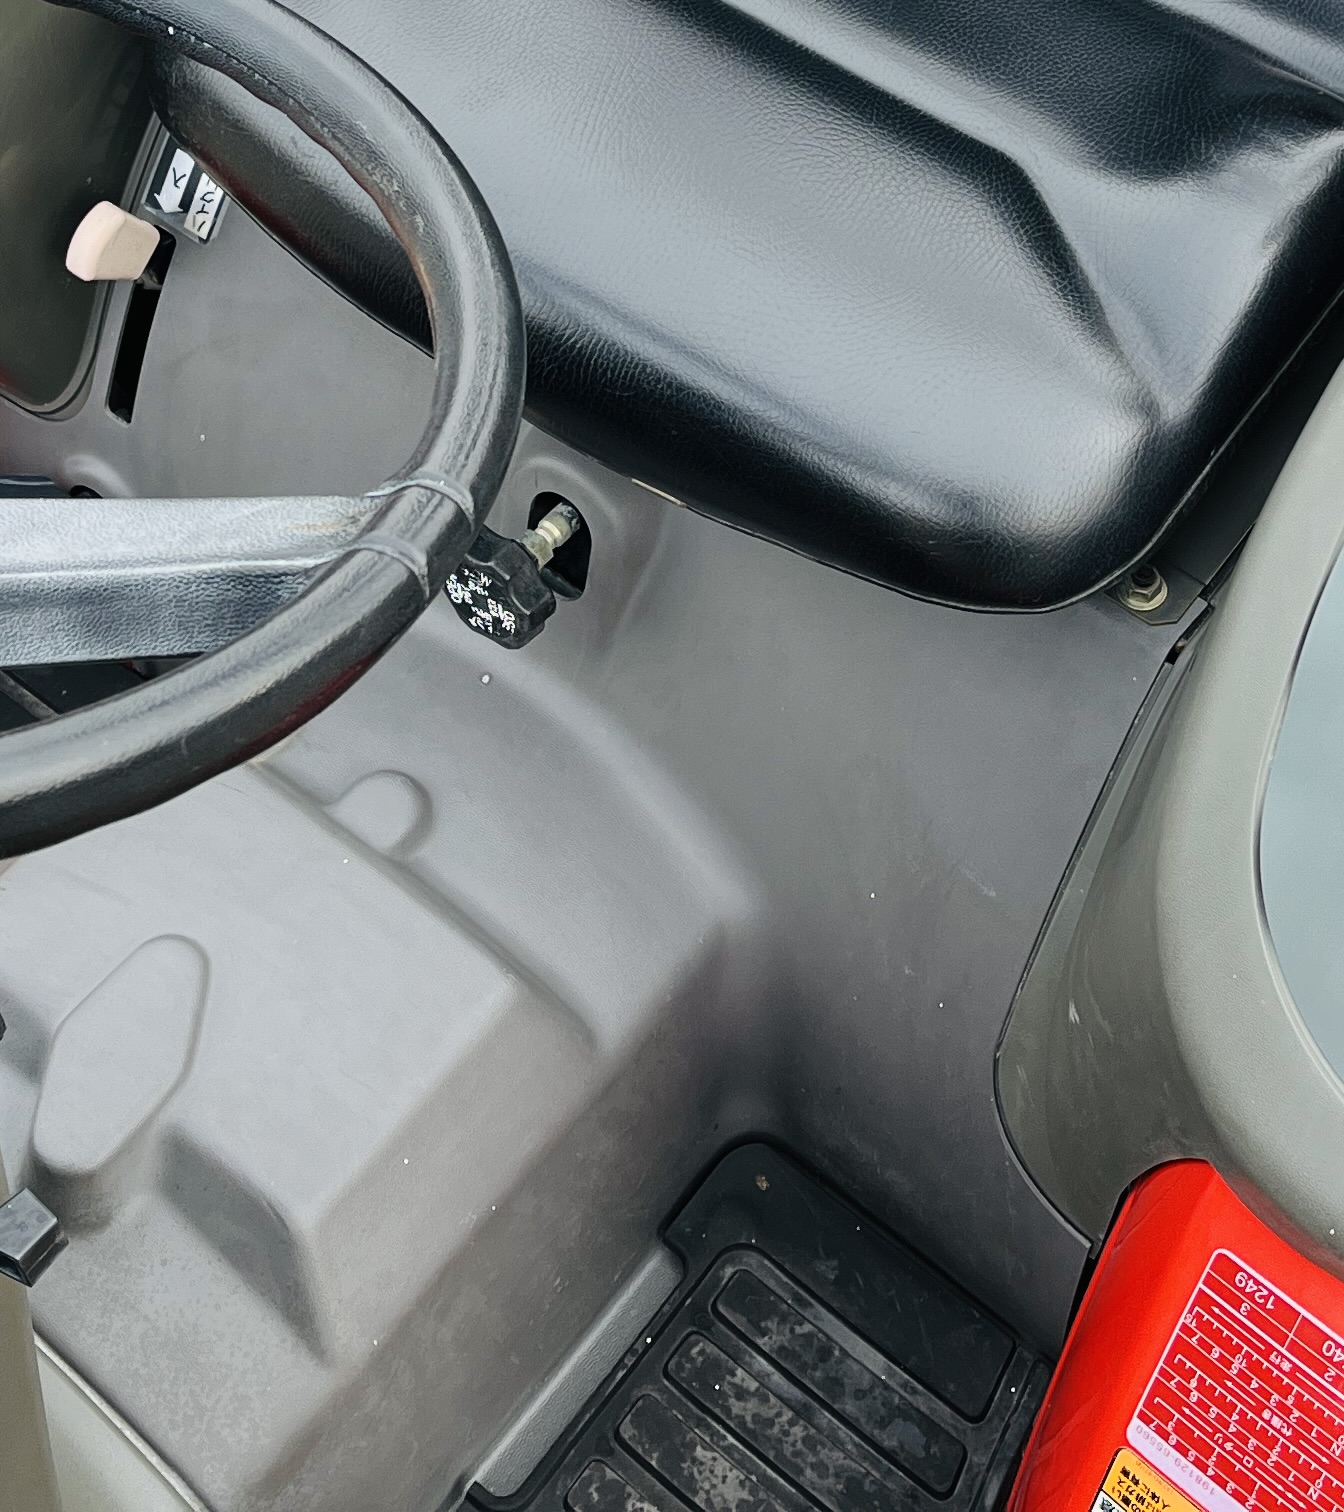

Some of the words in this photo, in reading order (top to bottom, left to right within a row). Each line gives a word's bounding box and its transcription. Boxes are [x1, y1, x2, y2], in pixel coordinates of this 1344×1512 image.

[1233, 1271, 1276, 1310] 1249
[1239, 1302, 1253, 1317] 3
[1324, 1368, 1338, 1383] 2
[1135, 1424, 1216, 1496] 198129-65560
[1327, 1440, 1344, 1457] N
[1306, 1484, 1321, 1501] N
